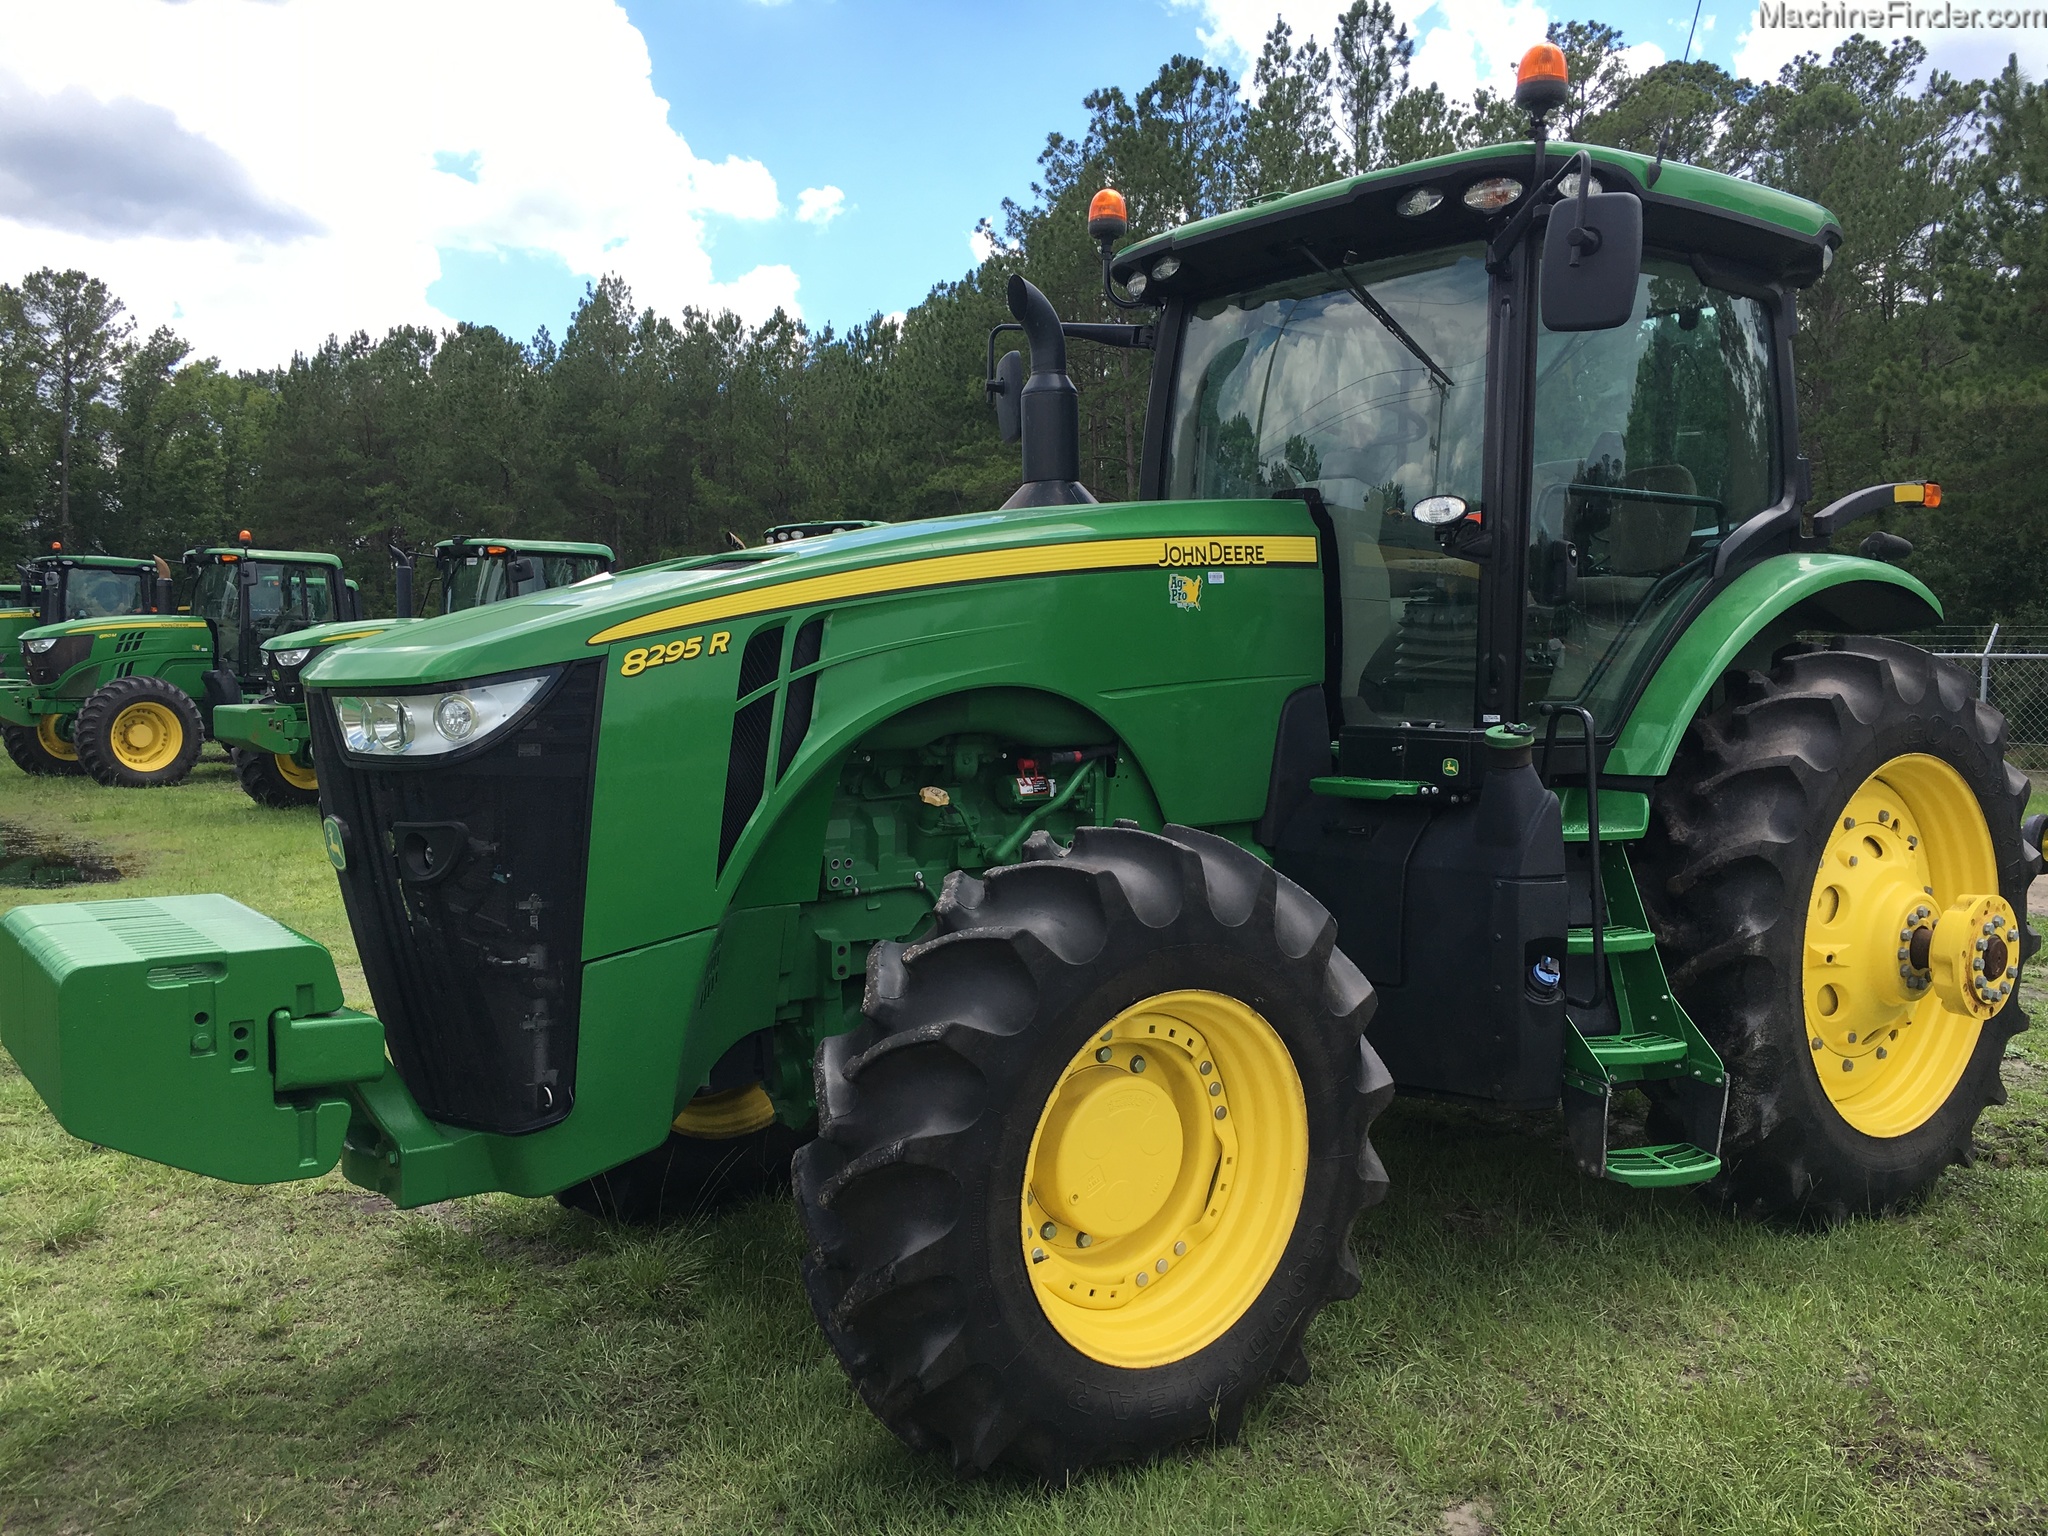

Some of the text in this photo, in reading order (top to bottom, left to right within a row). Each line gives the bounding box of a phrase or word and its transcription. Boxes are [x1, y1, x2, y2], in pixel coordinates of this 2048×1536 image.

[1171, 589, 1187, 601] Pro
[620, 631, 731, 677] 8295 R
